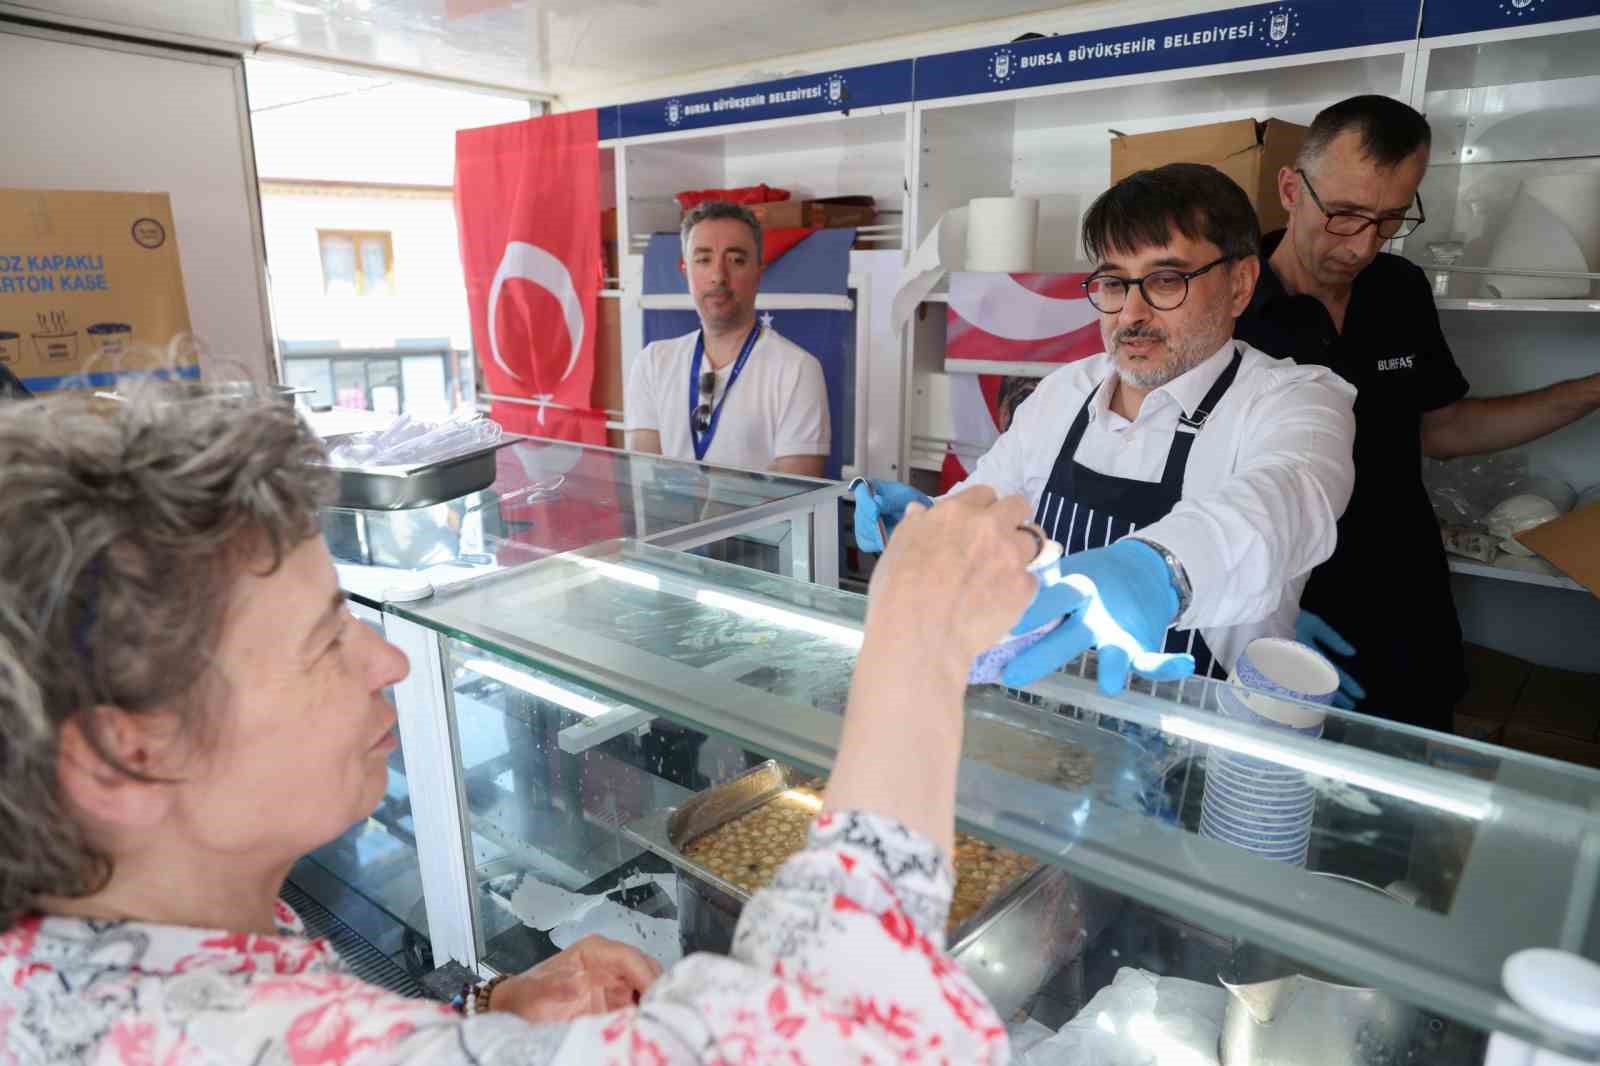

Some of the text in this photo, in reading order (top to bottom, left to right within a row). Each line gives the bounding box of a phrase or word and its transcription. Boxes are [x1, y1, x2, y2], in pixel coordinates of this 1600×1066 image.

[1020, 21, 1254, 69] BURSA BÜYÜKŞEHİR BELEDİYESİ
[684, 104, 711, 116] BURSA
[27, 255, 104, 272] KAPAKLI
